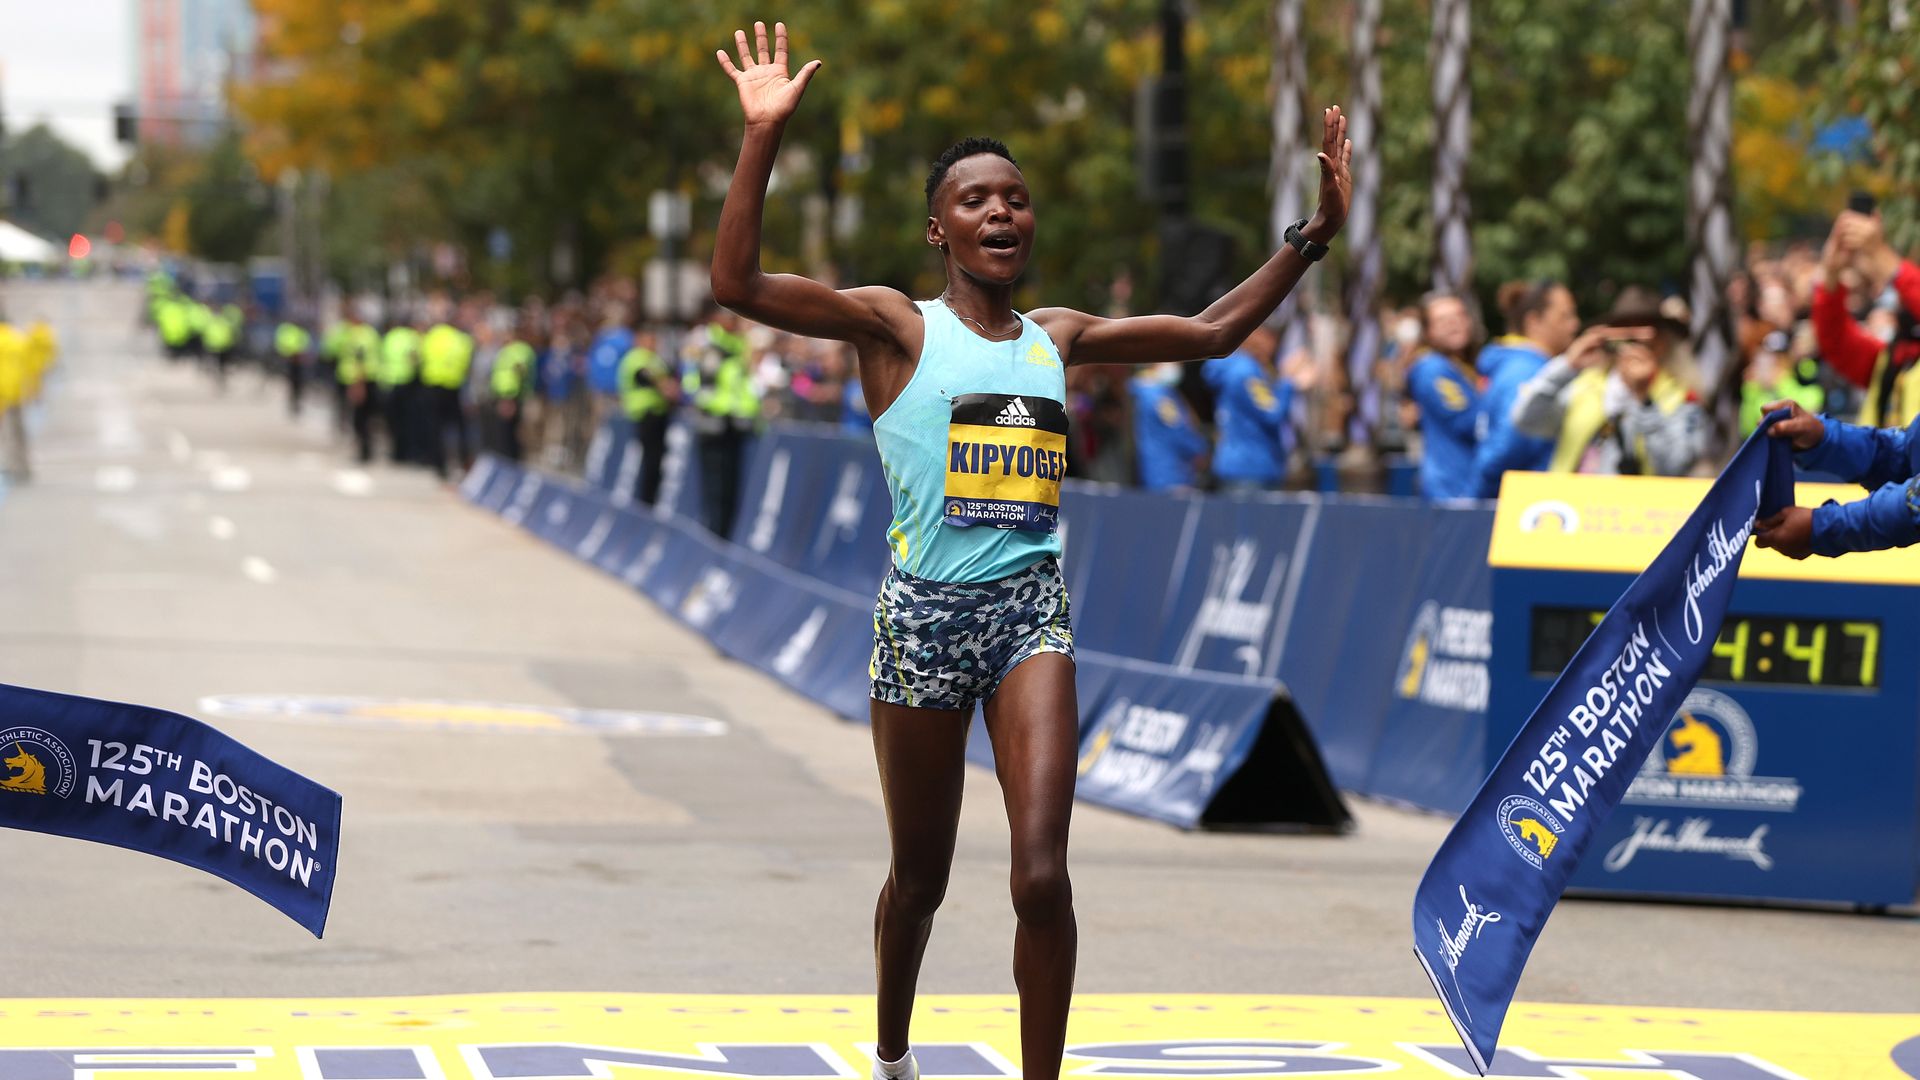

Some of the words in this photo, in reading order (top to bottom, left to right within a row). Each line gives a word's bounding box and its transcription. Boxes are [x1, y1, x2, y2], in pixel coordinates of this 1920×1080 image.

[994, 414, 1036, 426] adidas
[967, 502, 987, 510] 125TH
[988, 503, 1024, 512] BOSTON
[967, 511, 1024, 521] MARATHON
[1684, 553, 1718, 645] John
[1523, 725, 1572, 796] 125TH
[1568, 622, 1650, 738] BOSTON
[43, 737, 72, 795] ASSOCIATION
[88, 739, 182, 775] 125TH
[189, 760, 317, 851] BOSTON
[1511, 798, 1560, 832] ASSOCIATION
[1508, 835, 1540, 865] BOSTON
